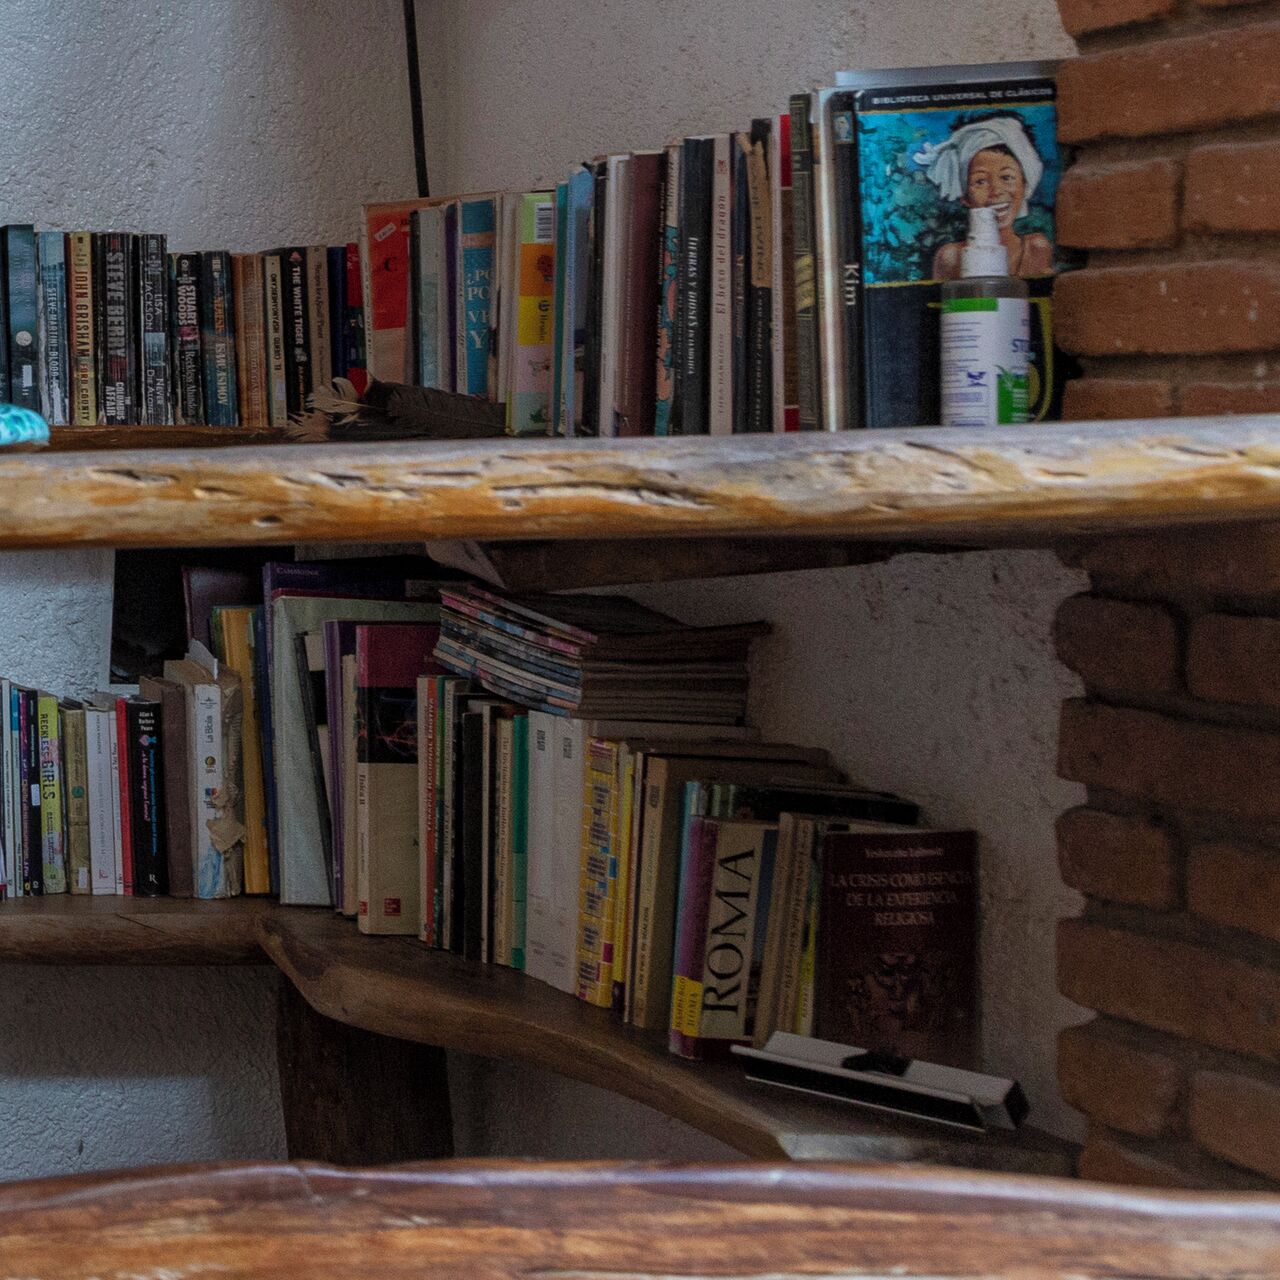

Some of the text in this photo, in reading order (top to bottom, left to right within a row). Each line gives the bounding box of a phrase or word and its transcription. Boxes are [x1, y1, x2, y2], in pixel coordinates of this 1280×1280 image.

[873, 86, 1053, 105] BIBLIOTECA UNIVERSAL DE CLÁSICOS
[106, 251, 125, 302] STEVE
[687, 237, 698, 277] TIERRAS
[716, 244, 725, 314] El beso del
[844, 263, 860, 306] Kim
[74, 269, 90, 360] JOHN GRISHAM
[143, 280, 154, 331] JACKSON
[154, 294, 162, 315] LISA
[177, 285, 187, 326] WOODS
[186, 285, 198, 326] STUART
[292, 266, 304, 344] THE WHITE TIGER
[186, 351, 195, 381] Reckless
[106, 386, 116, 417] AFFAIR
[116, 382, 126, 420] COLUMBUS
[216, 370, 228, 406] ASIMOV
[40, 713, 55, 800] RECKLESS GIRLS
[702, 849, 756, 1014] ROMA
